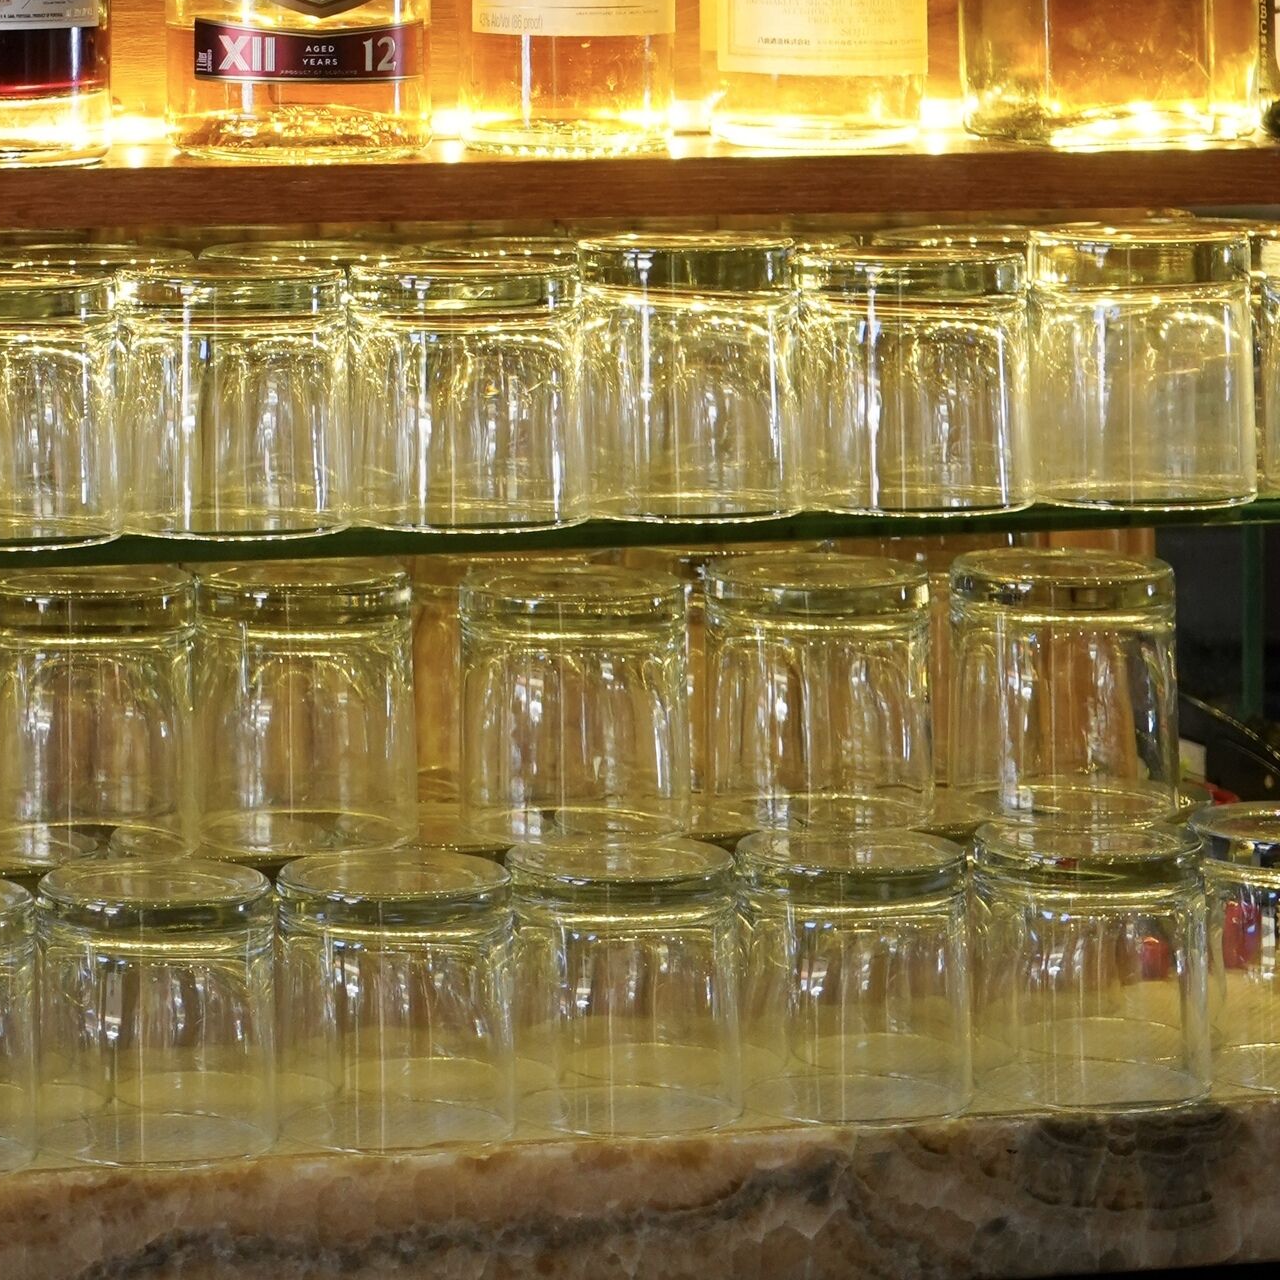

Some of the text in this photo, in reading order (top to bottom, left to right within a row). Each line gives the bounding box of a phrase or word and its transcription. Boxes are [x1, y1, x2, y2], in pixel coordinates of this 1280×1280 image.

[218, 35, 276, 72] XII
[302, 58, 339, 66] YEARS
[362, 36, 397, 72] 12
